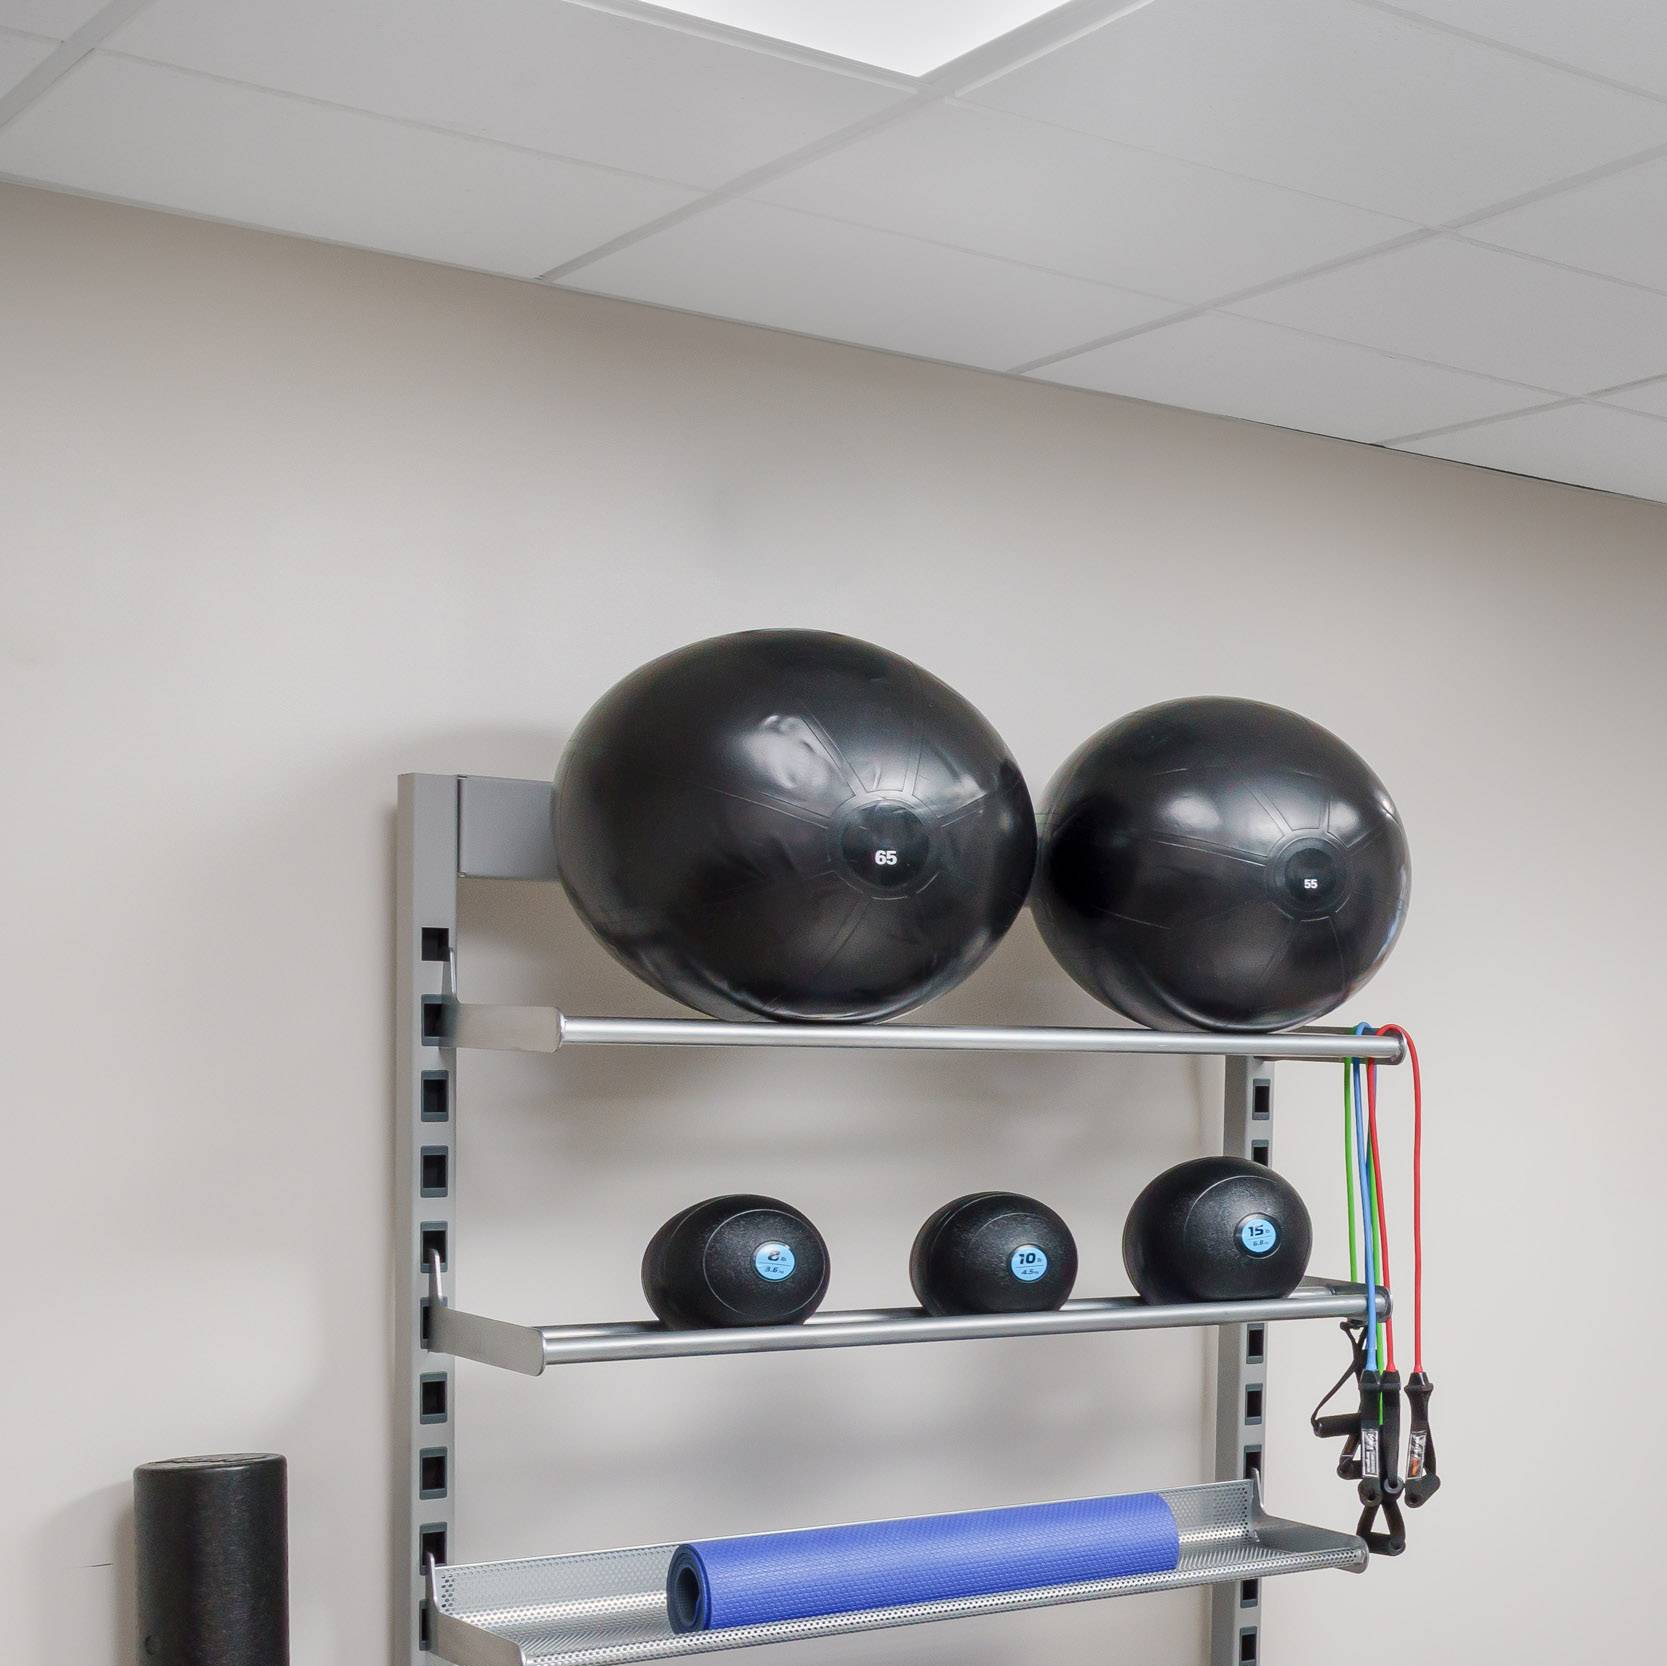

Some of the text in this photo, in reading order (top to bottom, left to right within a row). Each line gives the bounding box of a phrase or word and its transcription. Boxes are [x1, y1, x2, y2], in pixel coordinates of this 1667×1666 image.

[874, 850, 898, 866] 65
[1303, 878, 1318, 889] 55
[1248, 1225, 1264, 1236] 15
[1019, 1253, 1036, 1264] 10
